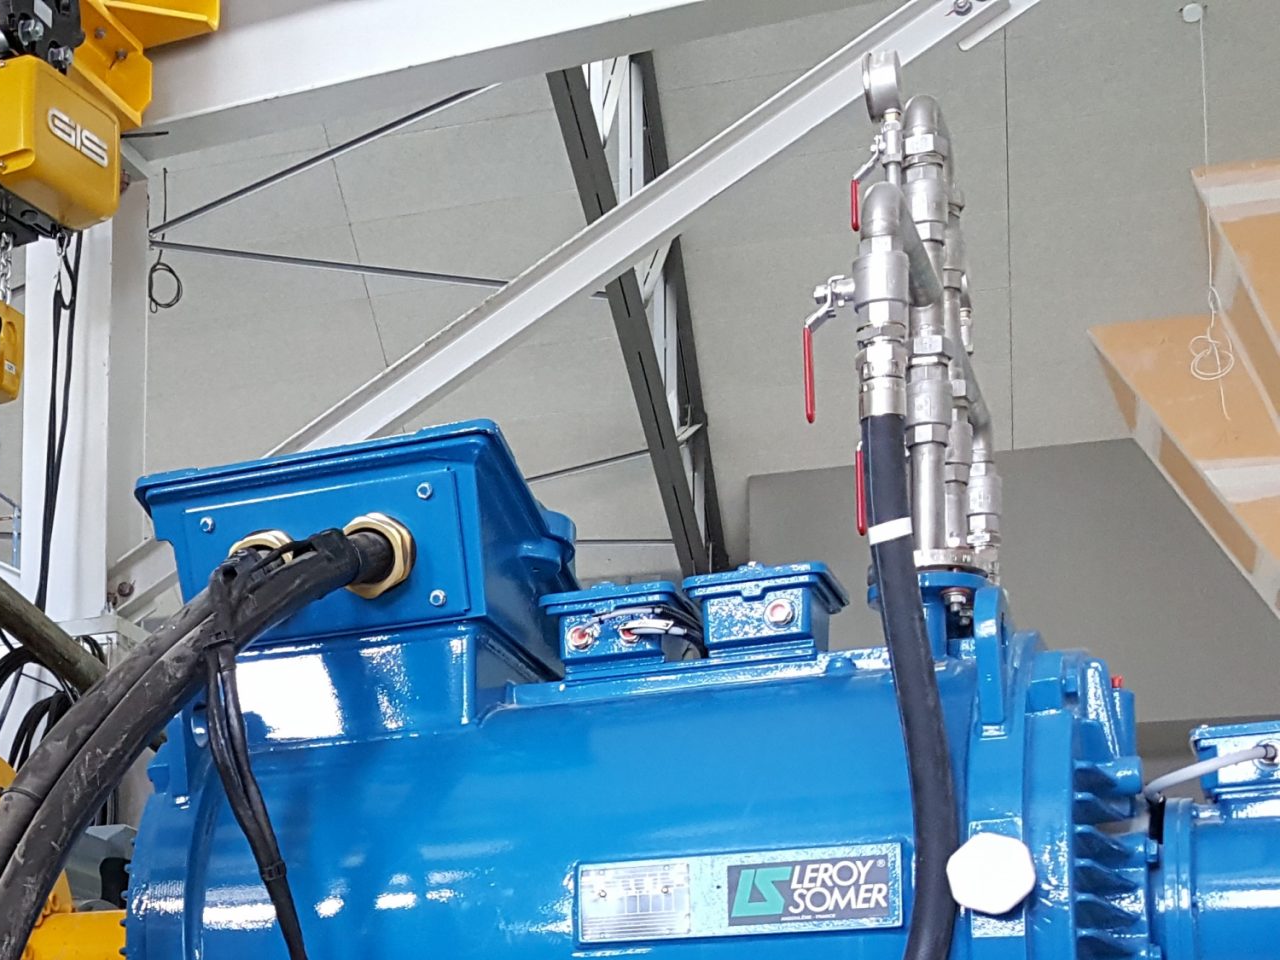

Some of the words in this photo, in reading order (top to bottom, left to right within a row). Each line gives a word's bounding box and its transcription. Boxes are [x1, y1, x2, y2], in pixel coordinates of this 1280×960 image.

[48, 108, 108, 168] GIS
[790, 860, 874, 889] LEROY
[788, 883, 888, 914] SOMER
